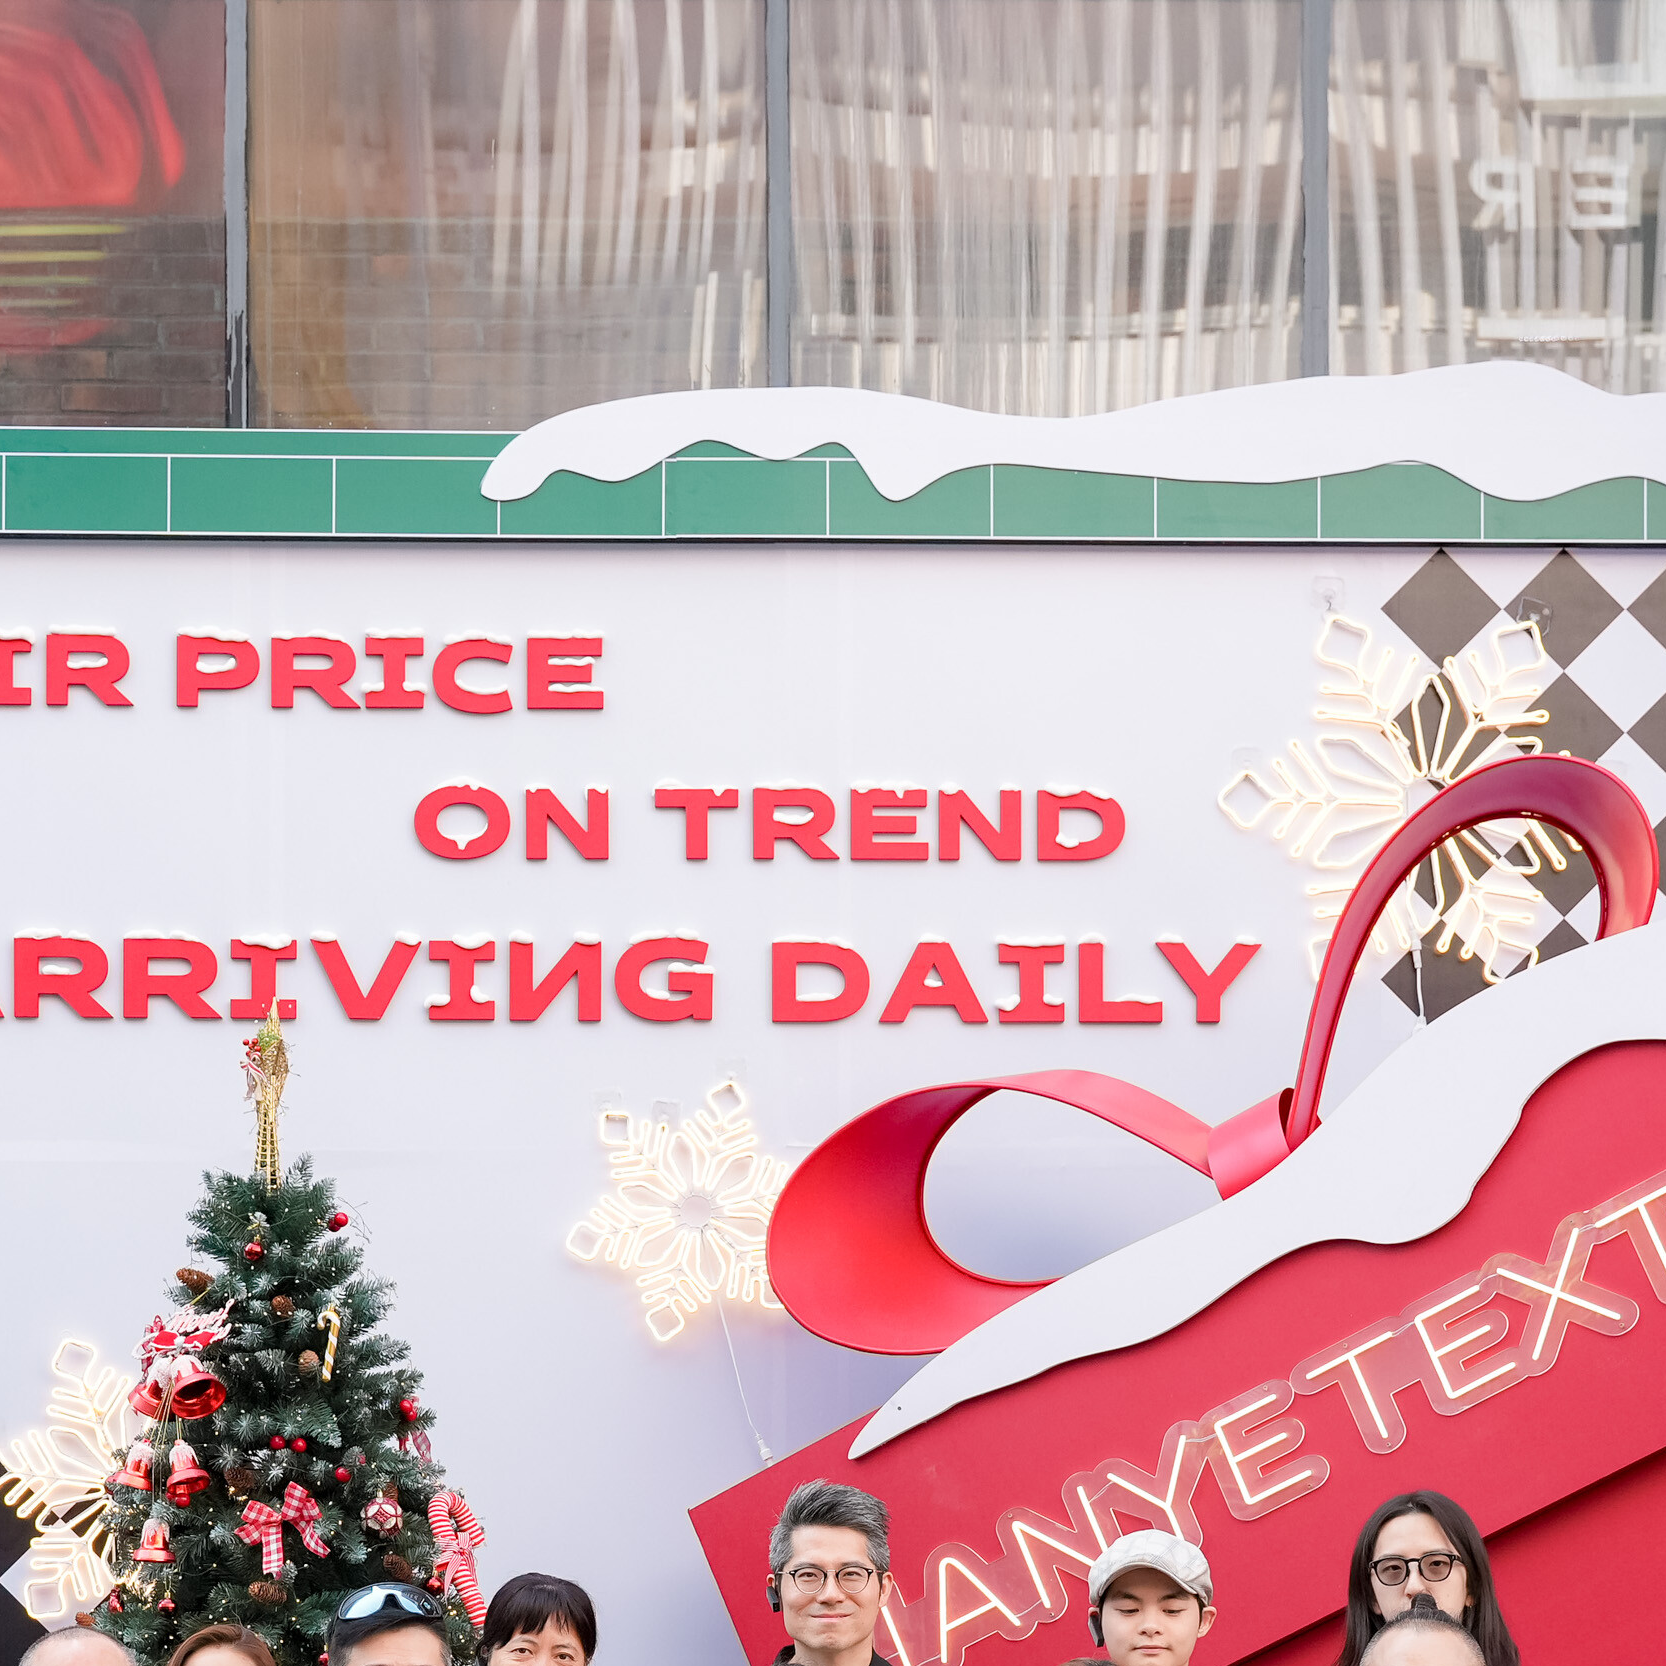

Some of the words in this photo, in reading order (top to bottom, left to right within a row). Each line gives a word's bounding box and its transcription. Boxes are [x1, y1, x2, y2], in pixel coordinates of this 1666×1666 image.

[176, 630, 605, 714] PRICE
[413, 784, 610, 862] ON
[653, 785, 1127, 863] TREND
[770, 938, 1263, 1025] DAILY
